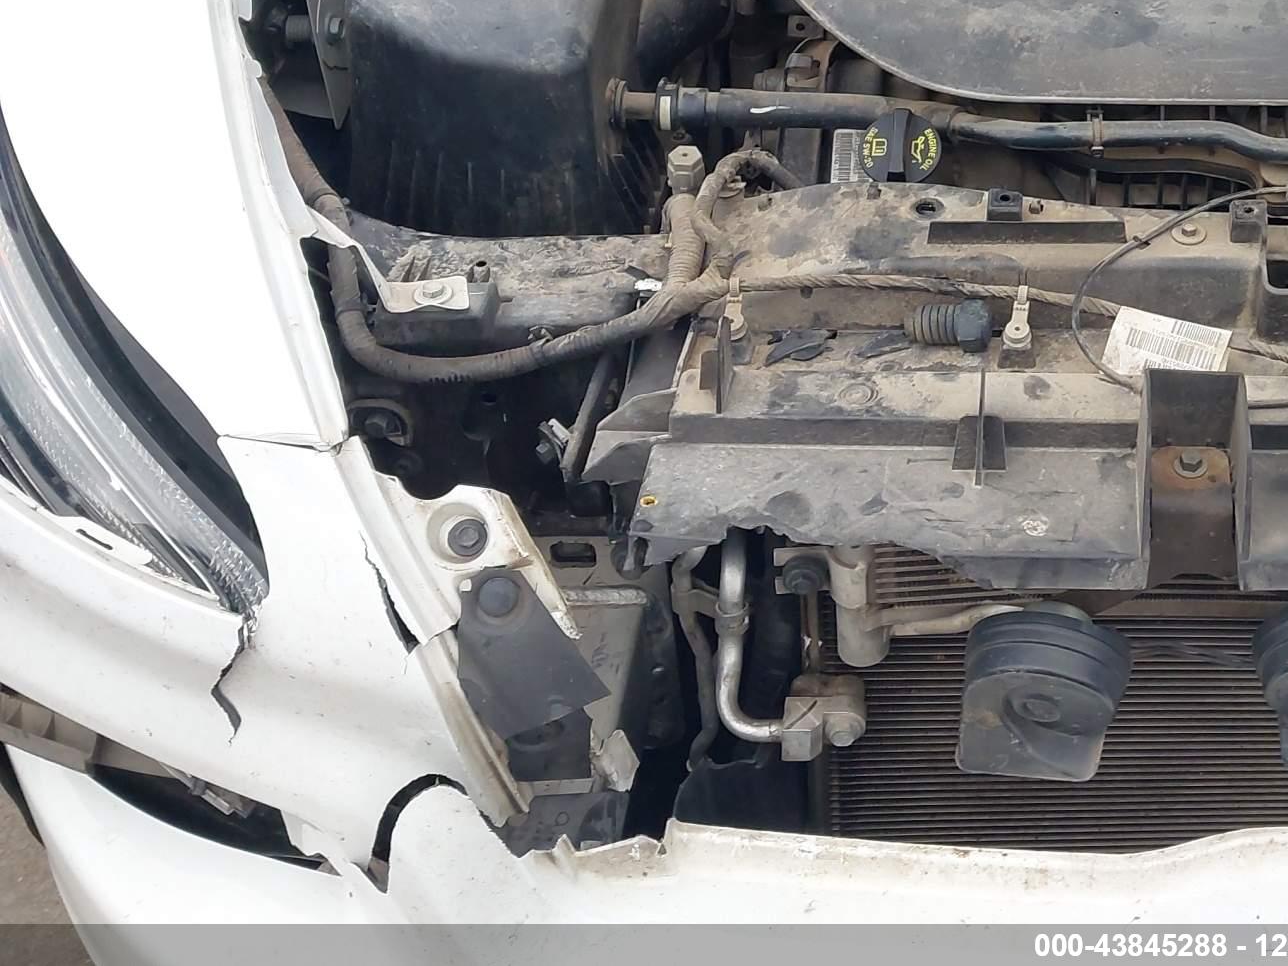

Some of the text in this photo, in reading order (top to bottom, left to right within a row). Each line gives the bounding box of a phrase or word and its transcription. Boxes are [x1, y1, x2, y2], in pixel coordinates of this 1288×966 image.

[864, 127, 878, 142] SAE
[919, 128, 938, 171] ENGINE OIL
